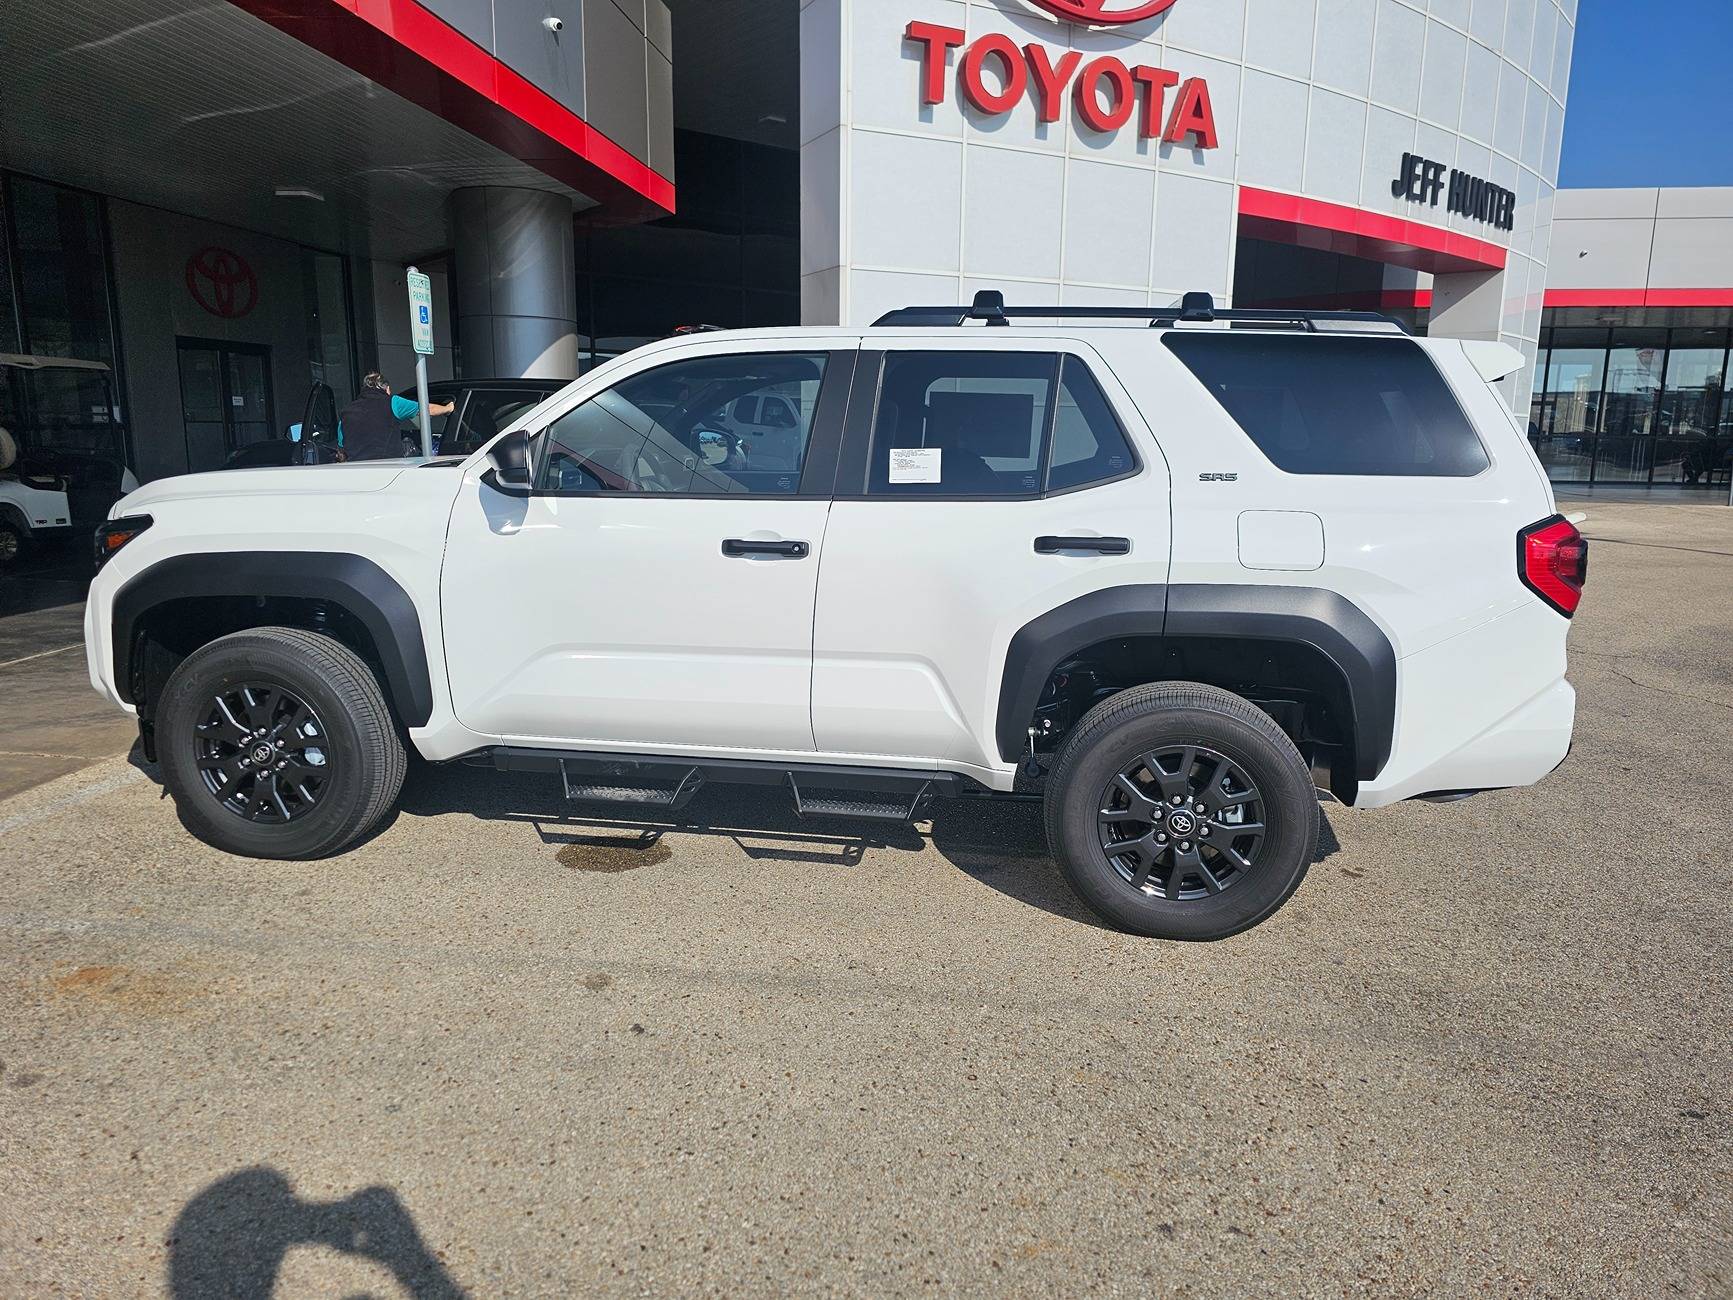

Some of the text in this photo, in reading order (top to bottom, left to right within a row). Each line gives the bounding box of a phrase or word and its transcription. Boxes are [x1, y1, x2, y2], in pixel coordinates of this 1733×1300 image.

[905, 20, 1218, 149] TOYOTA
[1391, 152, 1516, 233] JEFF HUNTER
